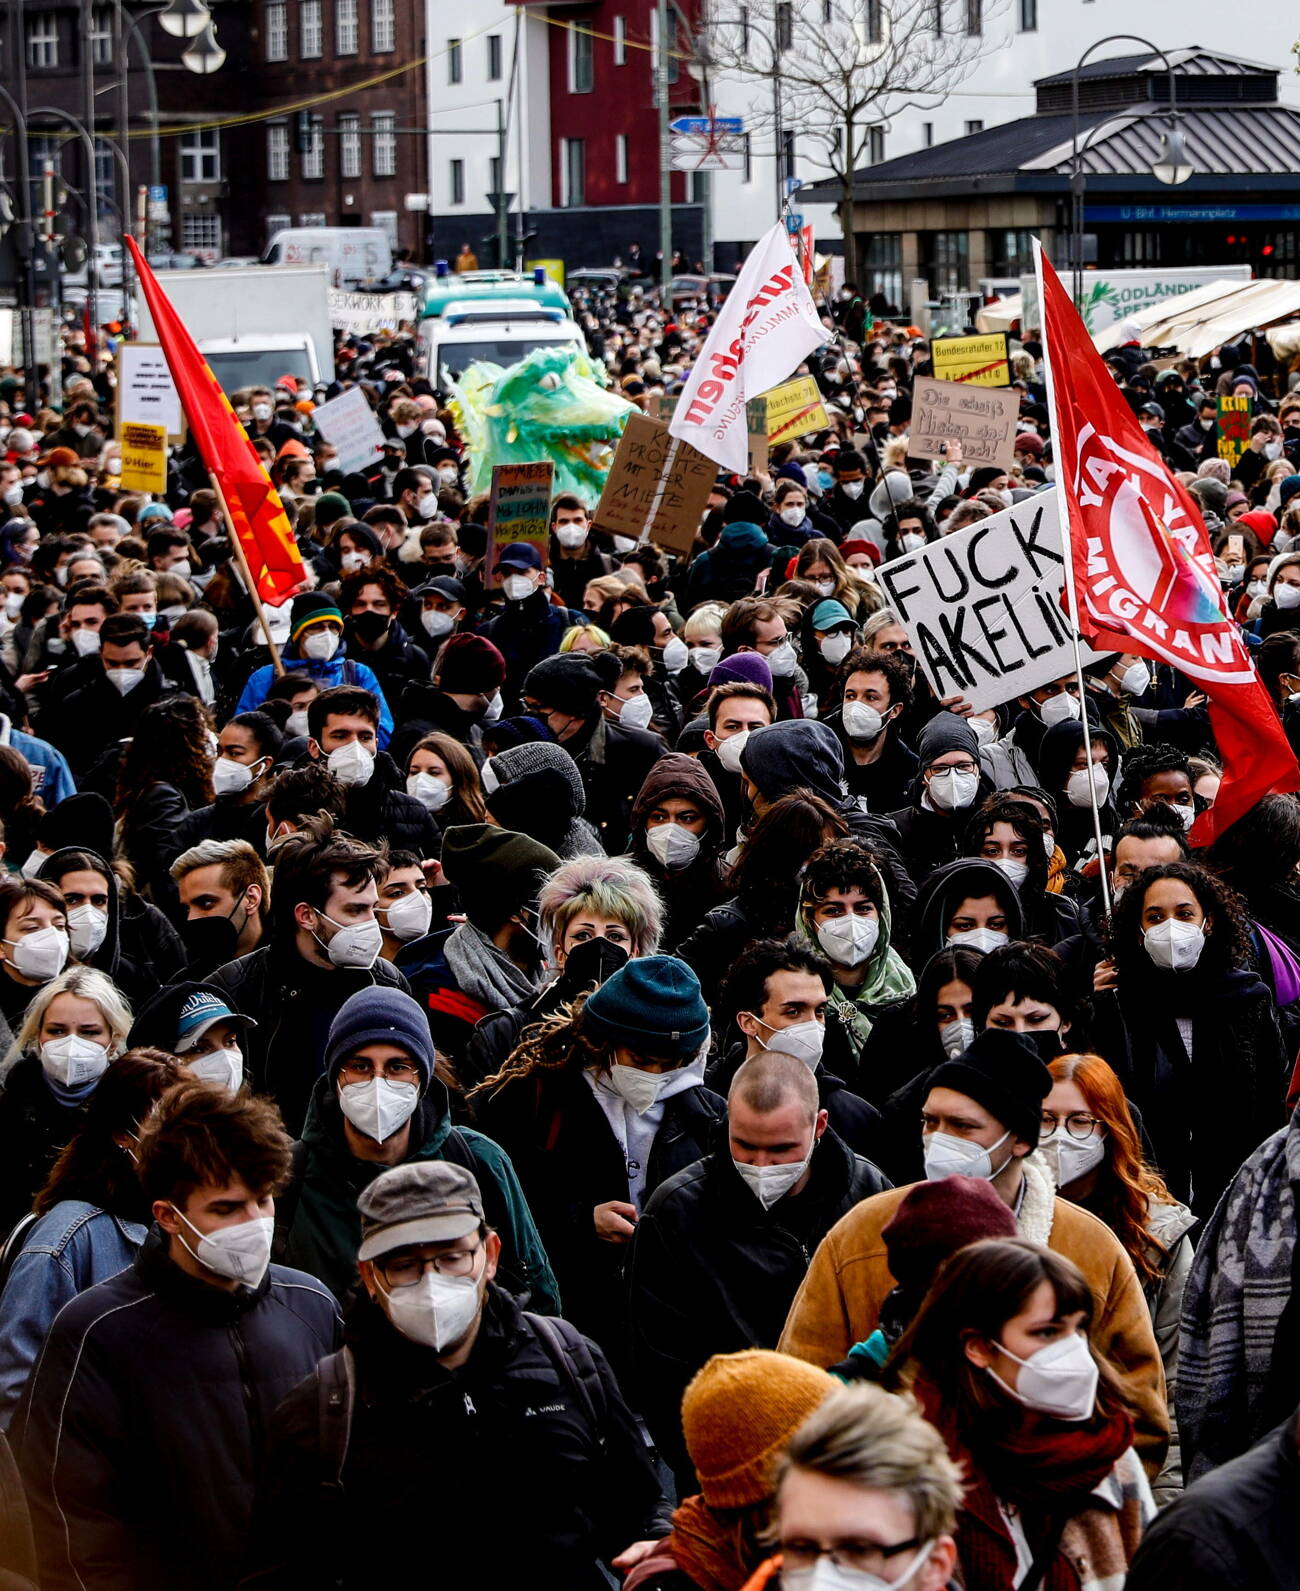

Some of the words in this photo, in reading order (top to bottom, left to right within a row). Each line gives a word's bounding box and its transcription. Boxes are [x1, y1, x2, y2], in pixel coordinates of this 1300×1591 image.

[1161, 207, 1237, 220] Hermannplatz
[921, 388, 950, 407] Die
[1220, 396, 1249, 412] KEIN
[918, 408, 969, 437] Mieten
[977, 421, 1010, 442] sind
[882, 507, 1064, 623] FUCK
